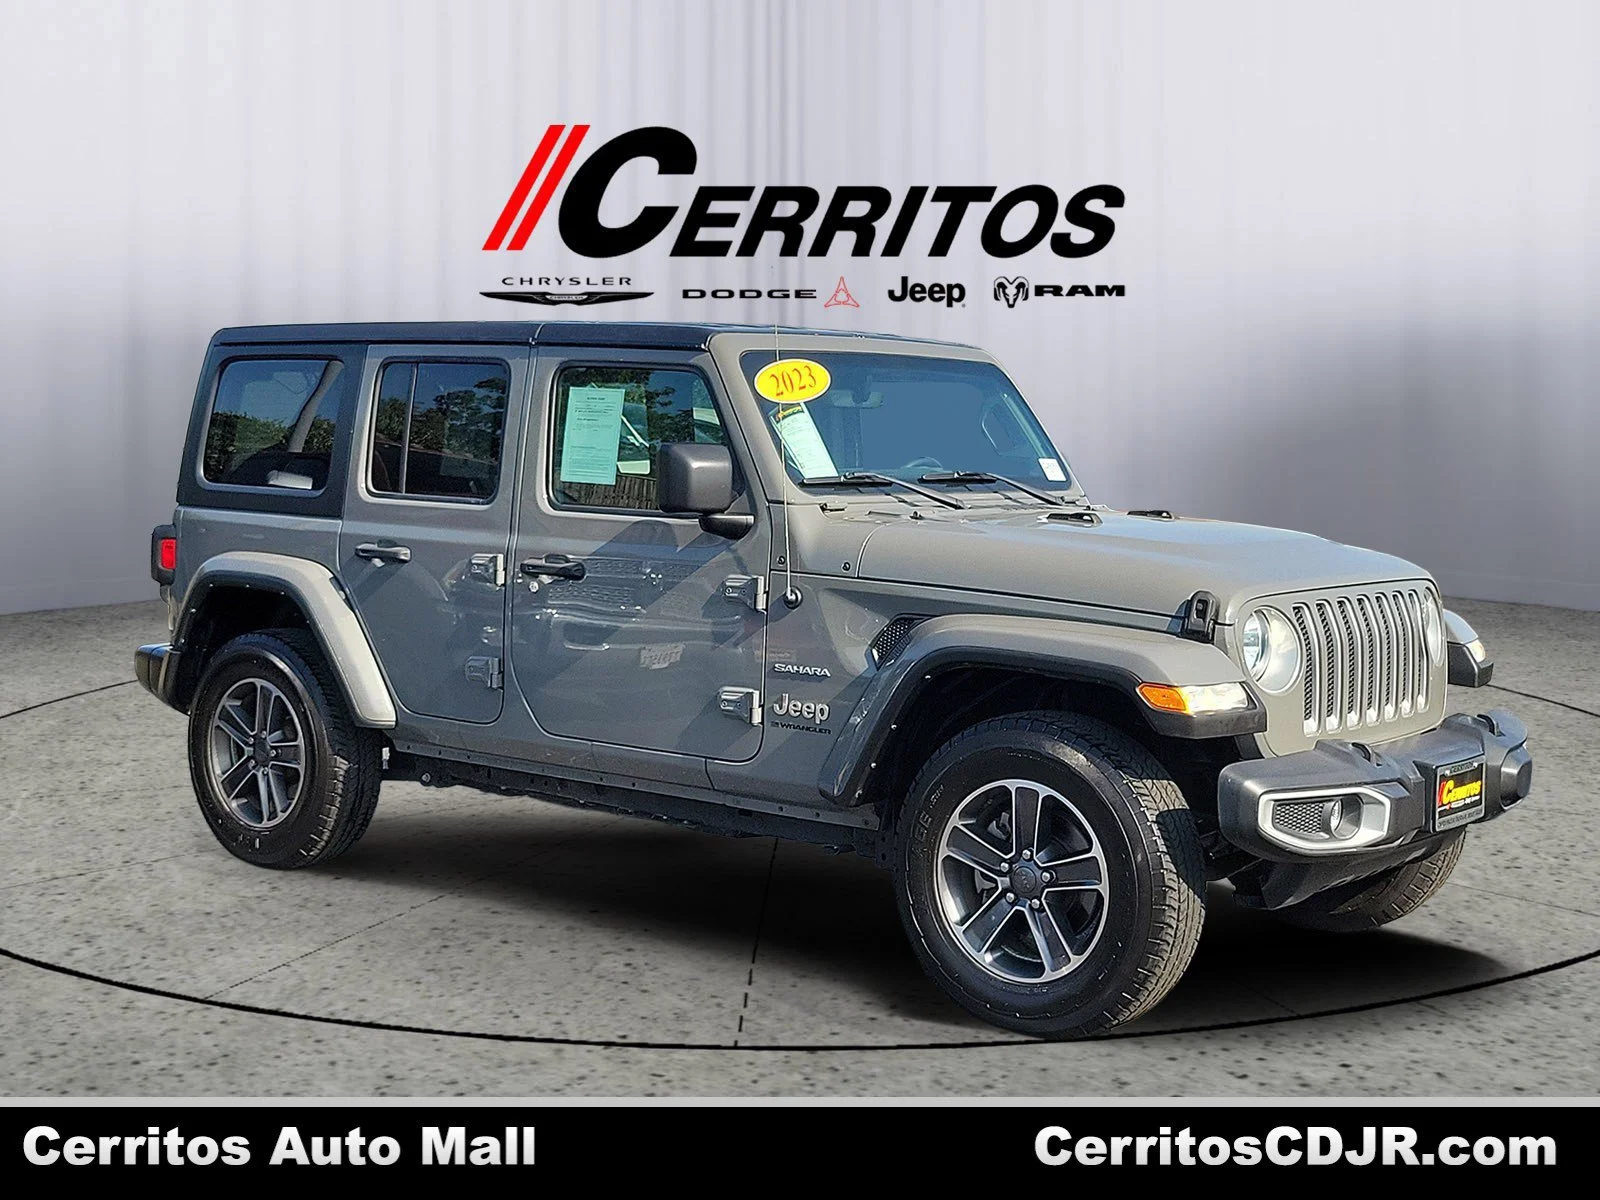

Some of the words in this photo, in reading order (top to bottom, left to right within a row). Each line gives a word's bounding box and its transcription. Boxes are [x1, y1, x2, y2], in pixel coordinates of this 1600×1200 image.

[769, 364, 817, 397] 2023
[774, 662, 832, 677] SAHARA
[773, 693, 830, 725] Jeep
[780, 721, 832, 735] WRANGLER
